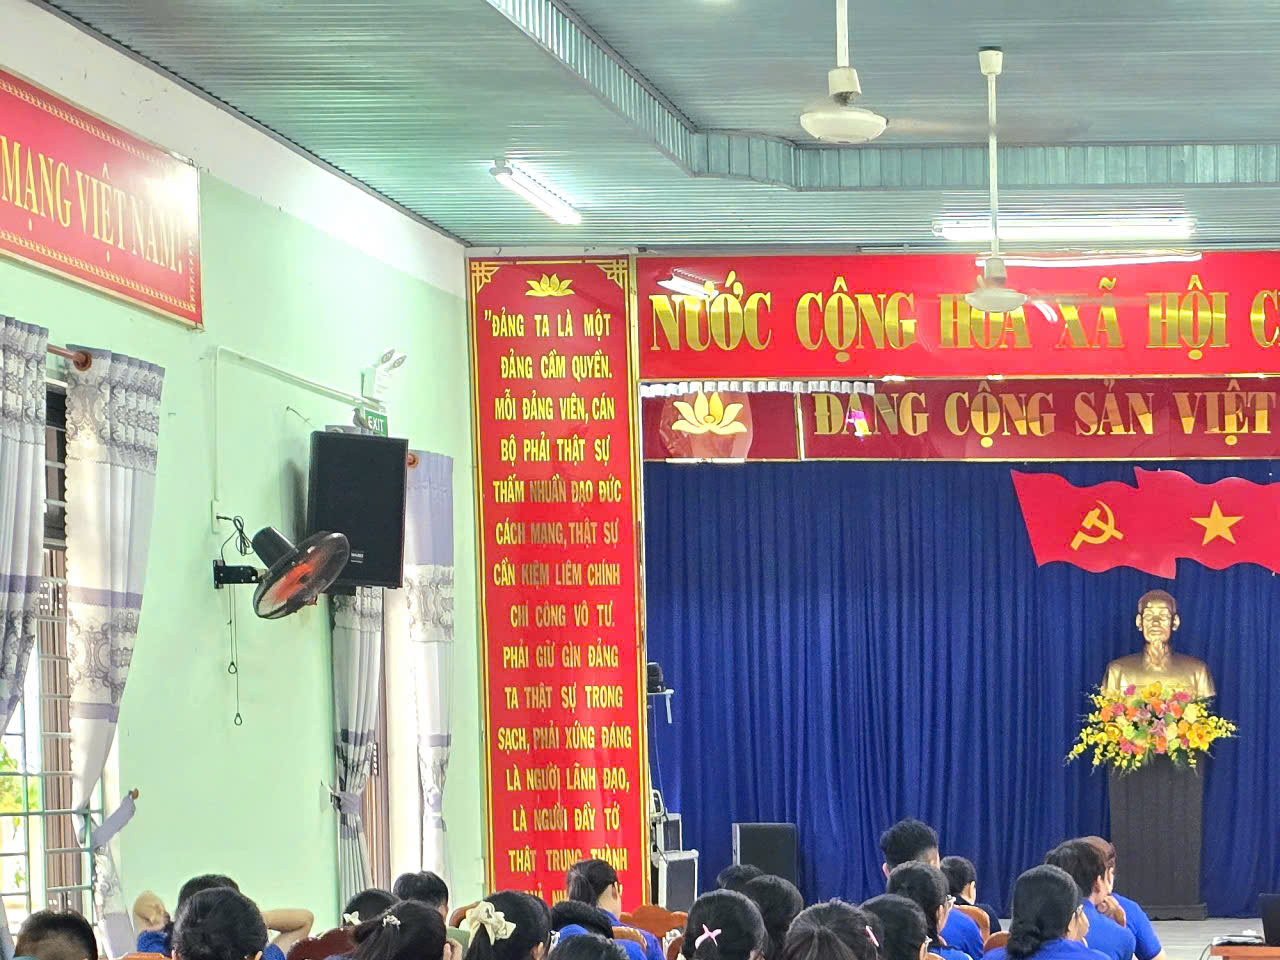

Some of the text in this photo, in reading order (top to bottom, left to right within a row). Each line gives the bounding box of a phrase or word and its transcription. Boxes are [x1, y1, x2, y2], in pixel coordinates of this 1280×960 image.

[0, 135, 72, 231] MẠNG
[75, 162, 127, 263] VIỆT
[534, 315, 550, 337] TA
[557, 308, 573, 337] LÀ
[583, 308, 611, 341] MỘT
[648, 270, 772, 352] NƯỚC
[795, 276, 917, 362] CỘNG
[1055, 277, 1125, 349] XÃ
[1146, 275, 1230, 360] HỘI
[501, 348, 612, 382] ĐẢNG CẦM QUYỀN.
[495, 388, 615, 424] MỖI ĐẢNG VIÊN, CÁN
[944, 381, 1056, 448] CỘNG
[1074, 380, 1154, 436] SẢN
[1173, 379, 1276, 445] VIỆT
[368, 415, 385, 432] EXIT
[500, 431, 611, 466] BỘ PHẢI THẬT SỰ
[493, 473, 622, 507] THẤM NHUẦN ĐẠO ĐỨC
[495, 517, 619, 549] CÁCH MẠNG, THẬT SỰ
[493, 557, 620, 590] CẦN KIỆM LIÊM CHÍNH
[510, 600, 615, 628] CHÍ CÔNG VÔ TƯ.
[503, 637, 619, 668] PHẢI GIỮ GÌN ĐẢNG
[504, 682, 623, 713] TA THẬT SỰ TRONG
[498, 720, 632, 755] SẠCH, PHẢI XỨNG ĐÁNG
[506, 761, 630, 794] LÀ NGƯỜI LÃNH ĐẠO,
[512, 801, 620, 832] LÀ NGƯỜI ĐẦY TỚ
[508, 845, 536, 876] THẬT
